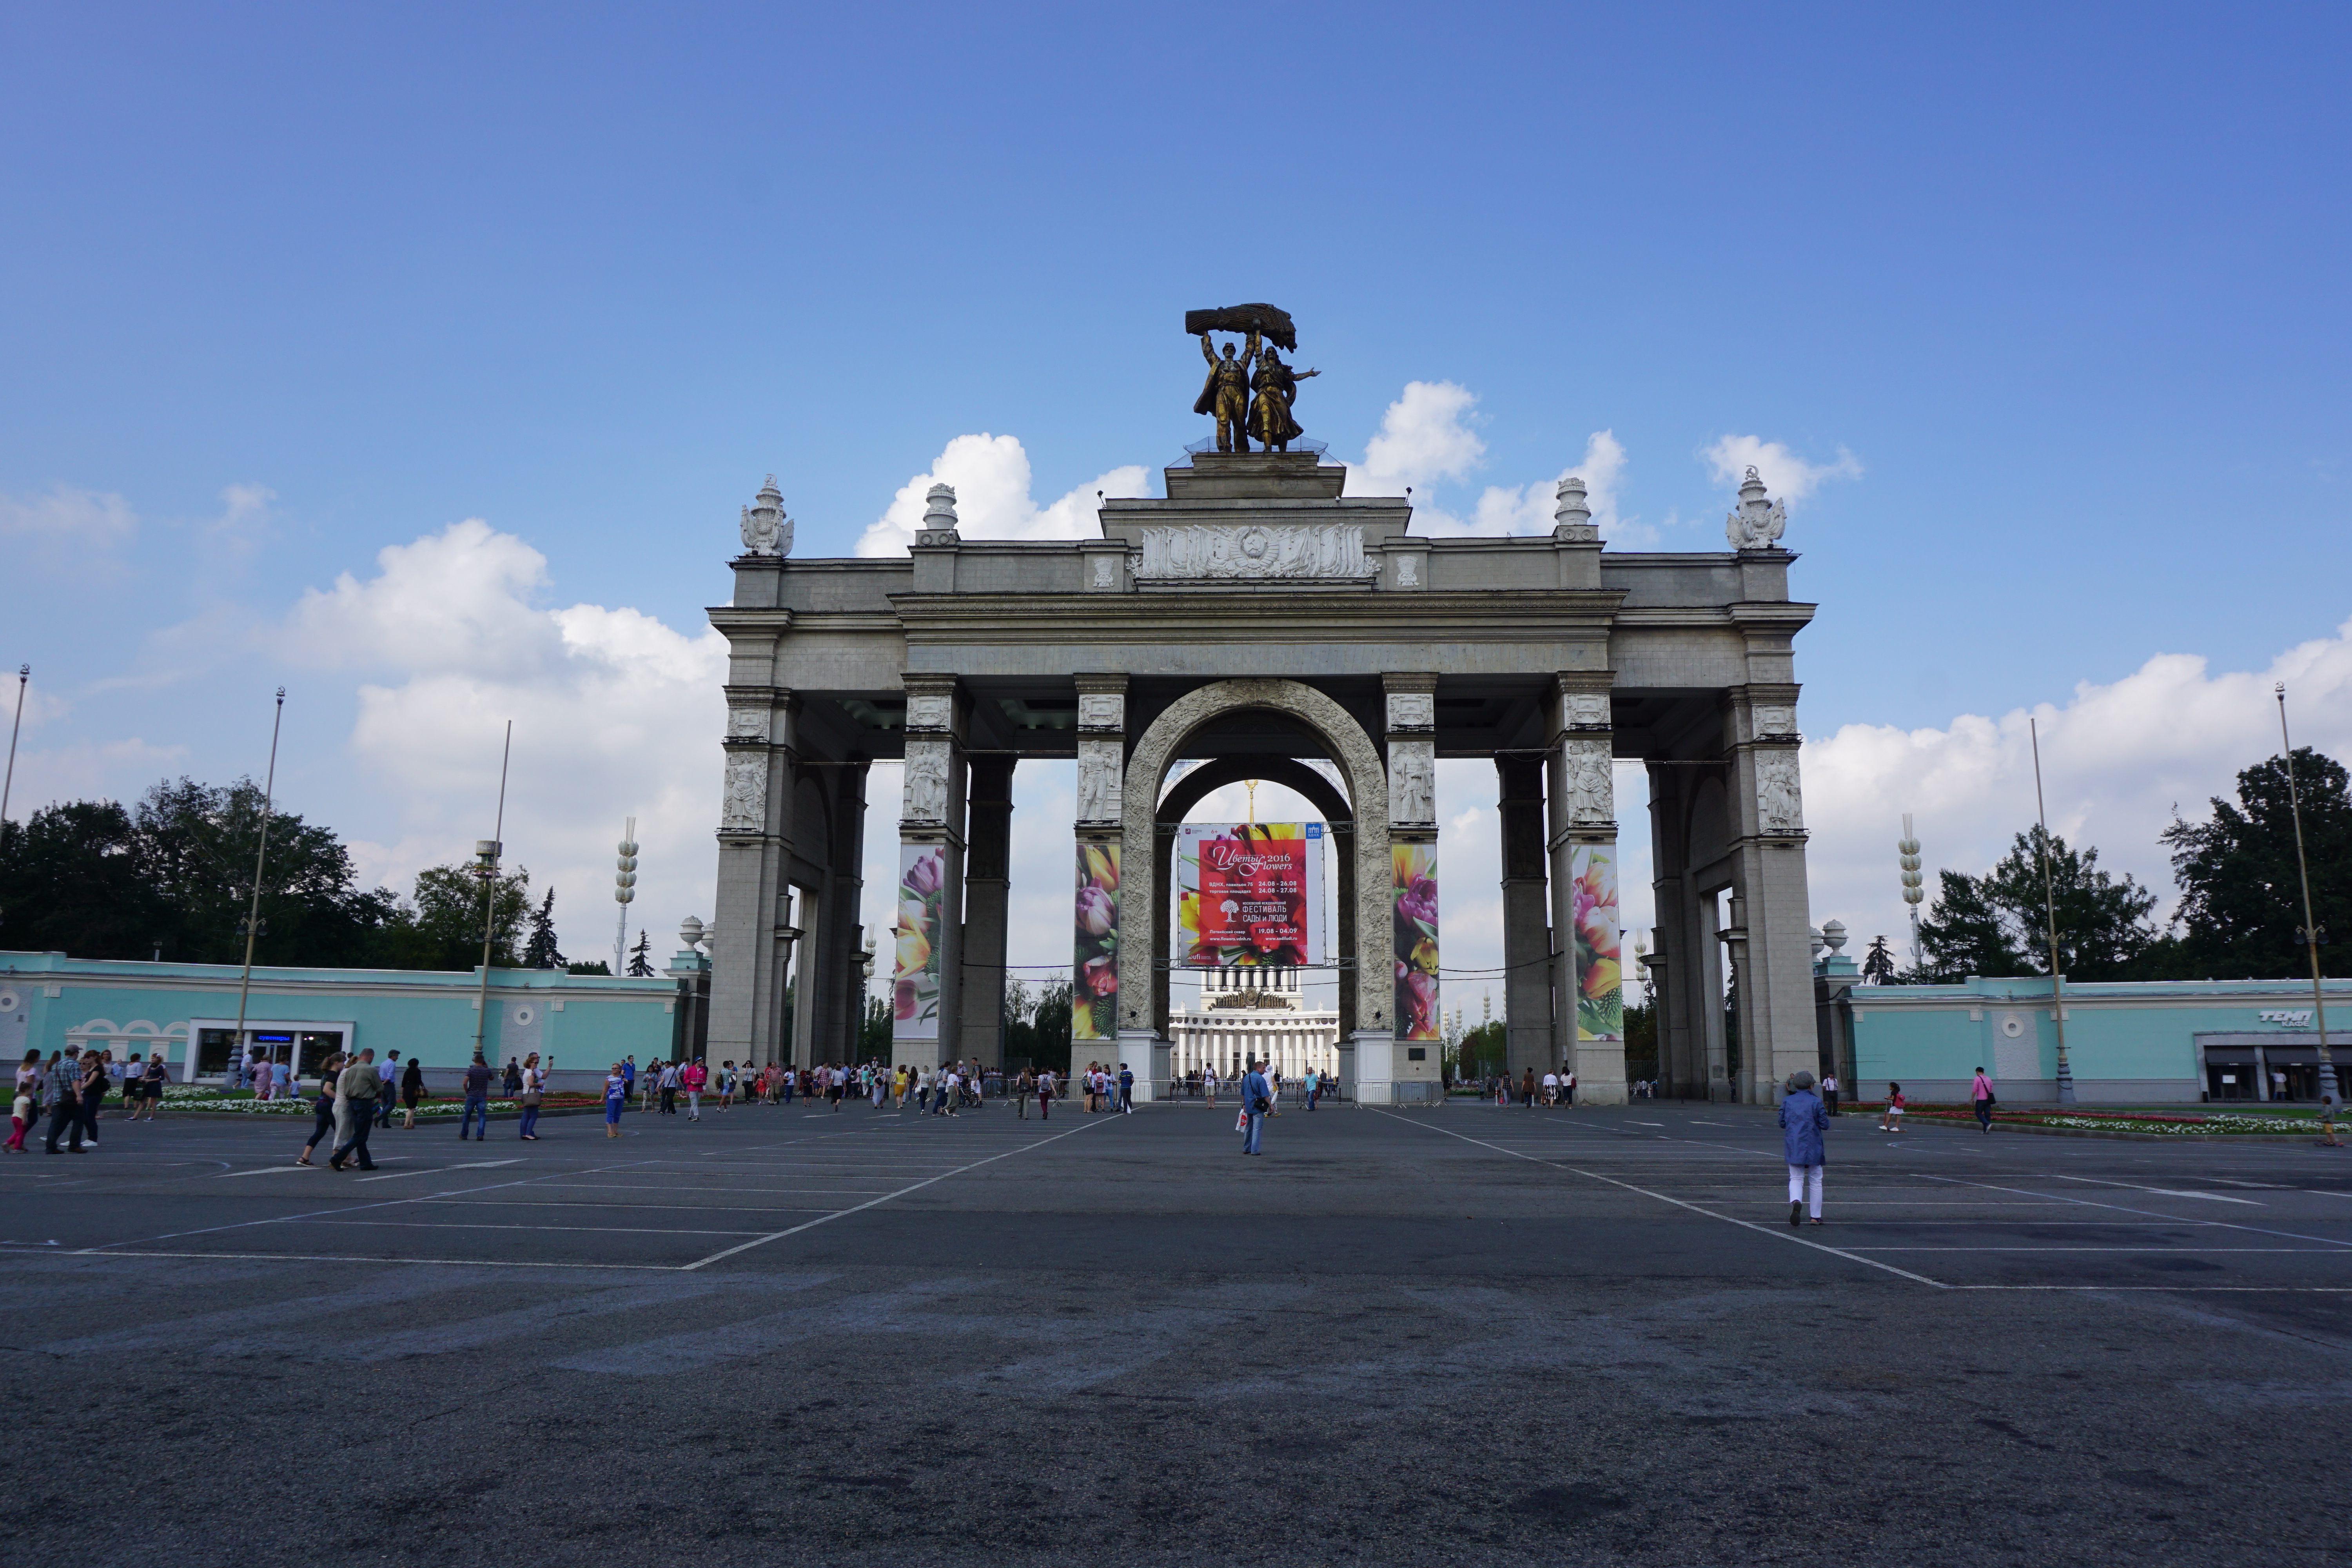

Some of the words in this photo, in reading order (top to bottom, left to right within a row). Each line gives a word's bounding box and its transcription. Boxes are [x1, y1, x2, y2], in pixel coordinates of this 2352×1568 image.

[1213, 846, 1259, 870] Цветы
[1267, 853, 1290, 862] 2016
[1243, 915, 1261, 923] САДЫ
[1268, 914, 1287, 923] ЛЮДИ
[2258, 1011, 2313, 1021] ТЕМП
